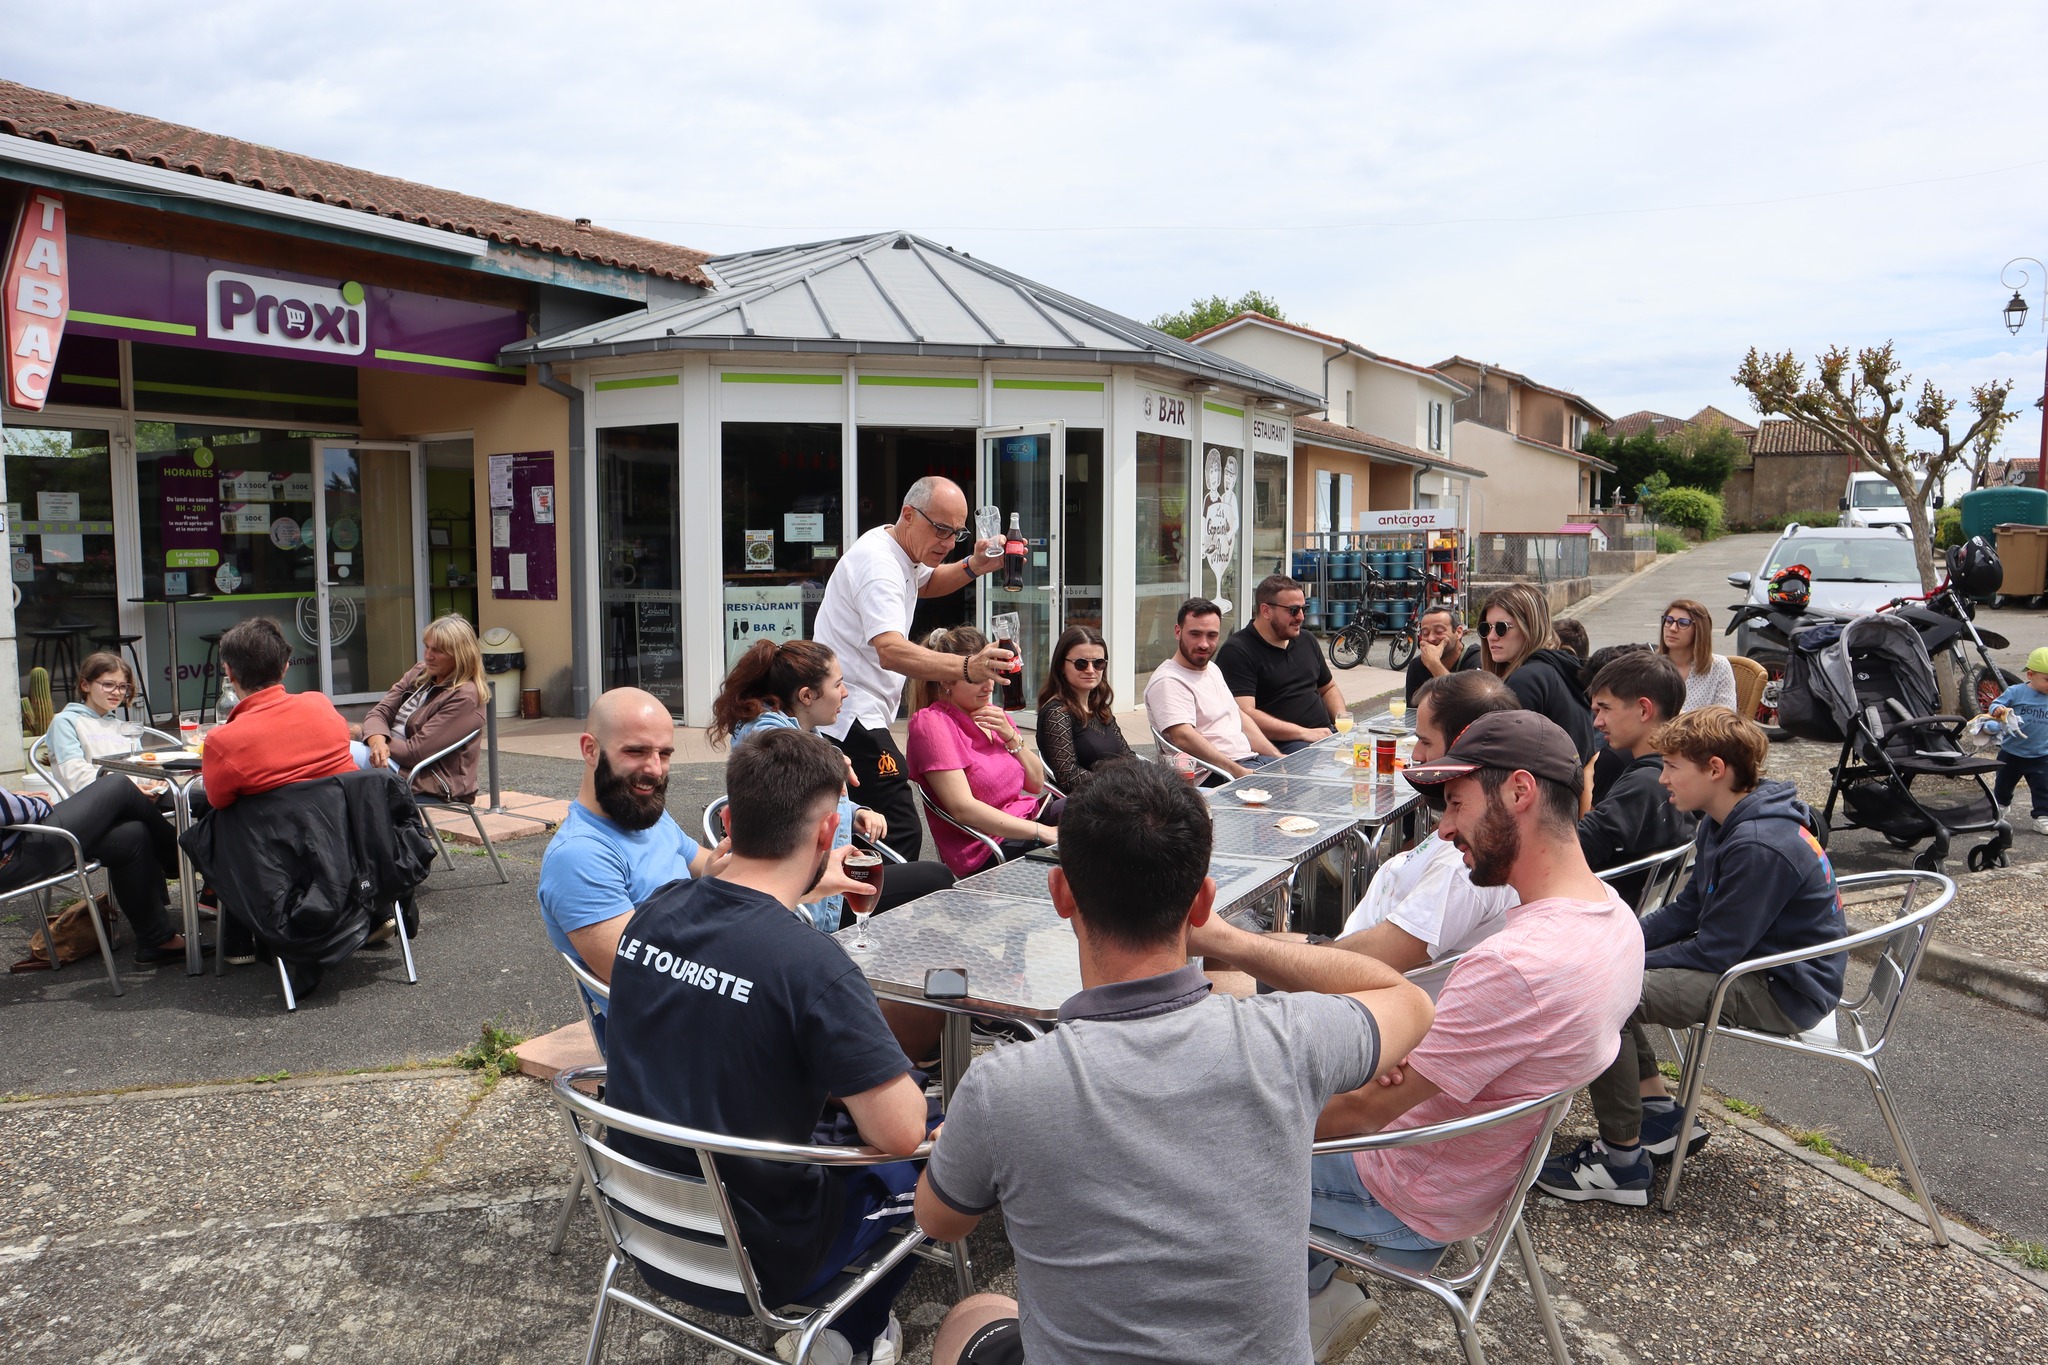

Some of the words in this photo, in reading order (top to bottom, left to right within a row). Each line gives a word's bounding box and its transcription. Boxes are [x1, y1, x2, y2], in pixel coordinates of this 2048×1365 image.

[15, 194, 63, 400] TABAC
[218, 279, 365, 346] Proxi
[1158, 395, 1185, 426] BAR
[1253, 420, 1286, 443] ESTAURANT
[163, 468, 214, 478] HORAIRES
[1378, 514, 1436, 527] antargaz
[178, 558, 188, 566] 8H
[727, 602, 800, 612] RESTAURANT
[753, 623, 776, 632] BAR
[616, 934, 642, 961] LE
[642, 944, 754, 1004] TOURISTE
